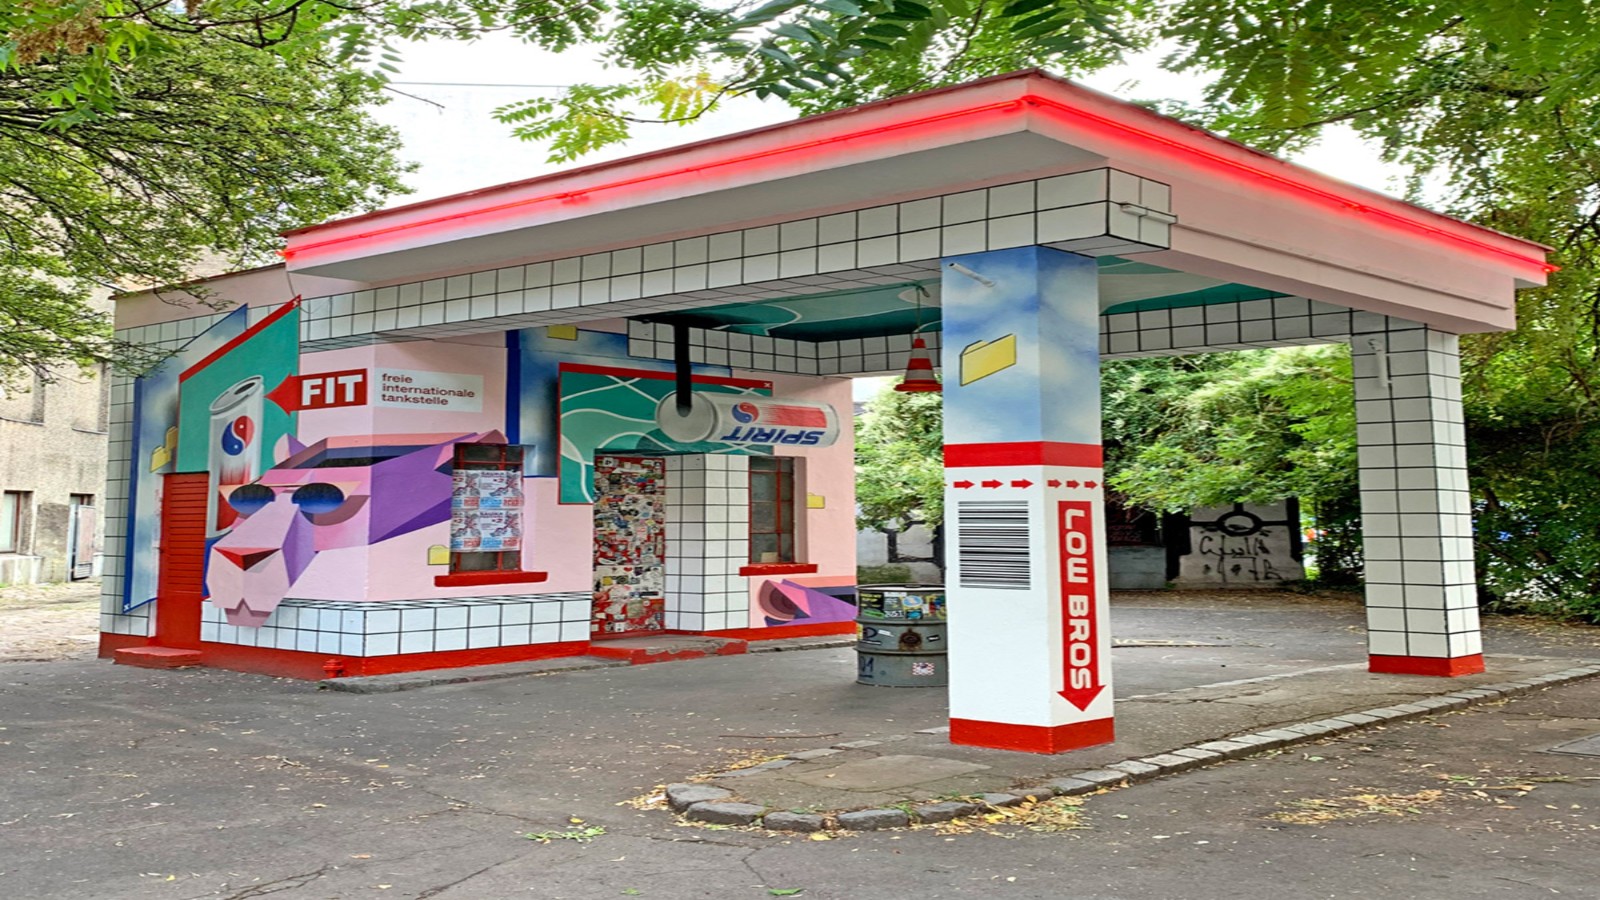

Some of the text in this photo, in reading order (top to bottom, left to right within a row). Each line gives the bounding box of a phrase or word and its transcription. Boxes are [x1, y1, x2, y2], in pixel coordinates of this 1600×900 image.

[382, 373, 413, 384] freie
[302, 374, 363, 406] FIT
[382, 384, 476, 398] internationale
[382, 394, 449, 405] tankstelle
[720, 426, 826, 445] SPIRIT
[1064, 508, 1092, 690] LOW BROS
